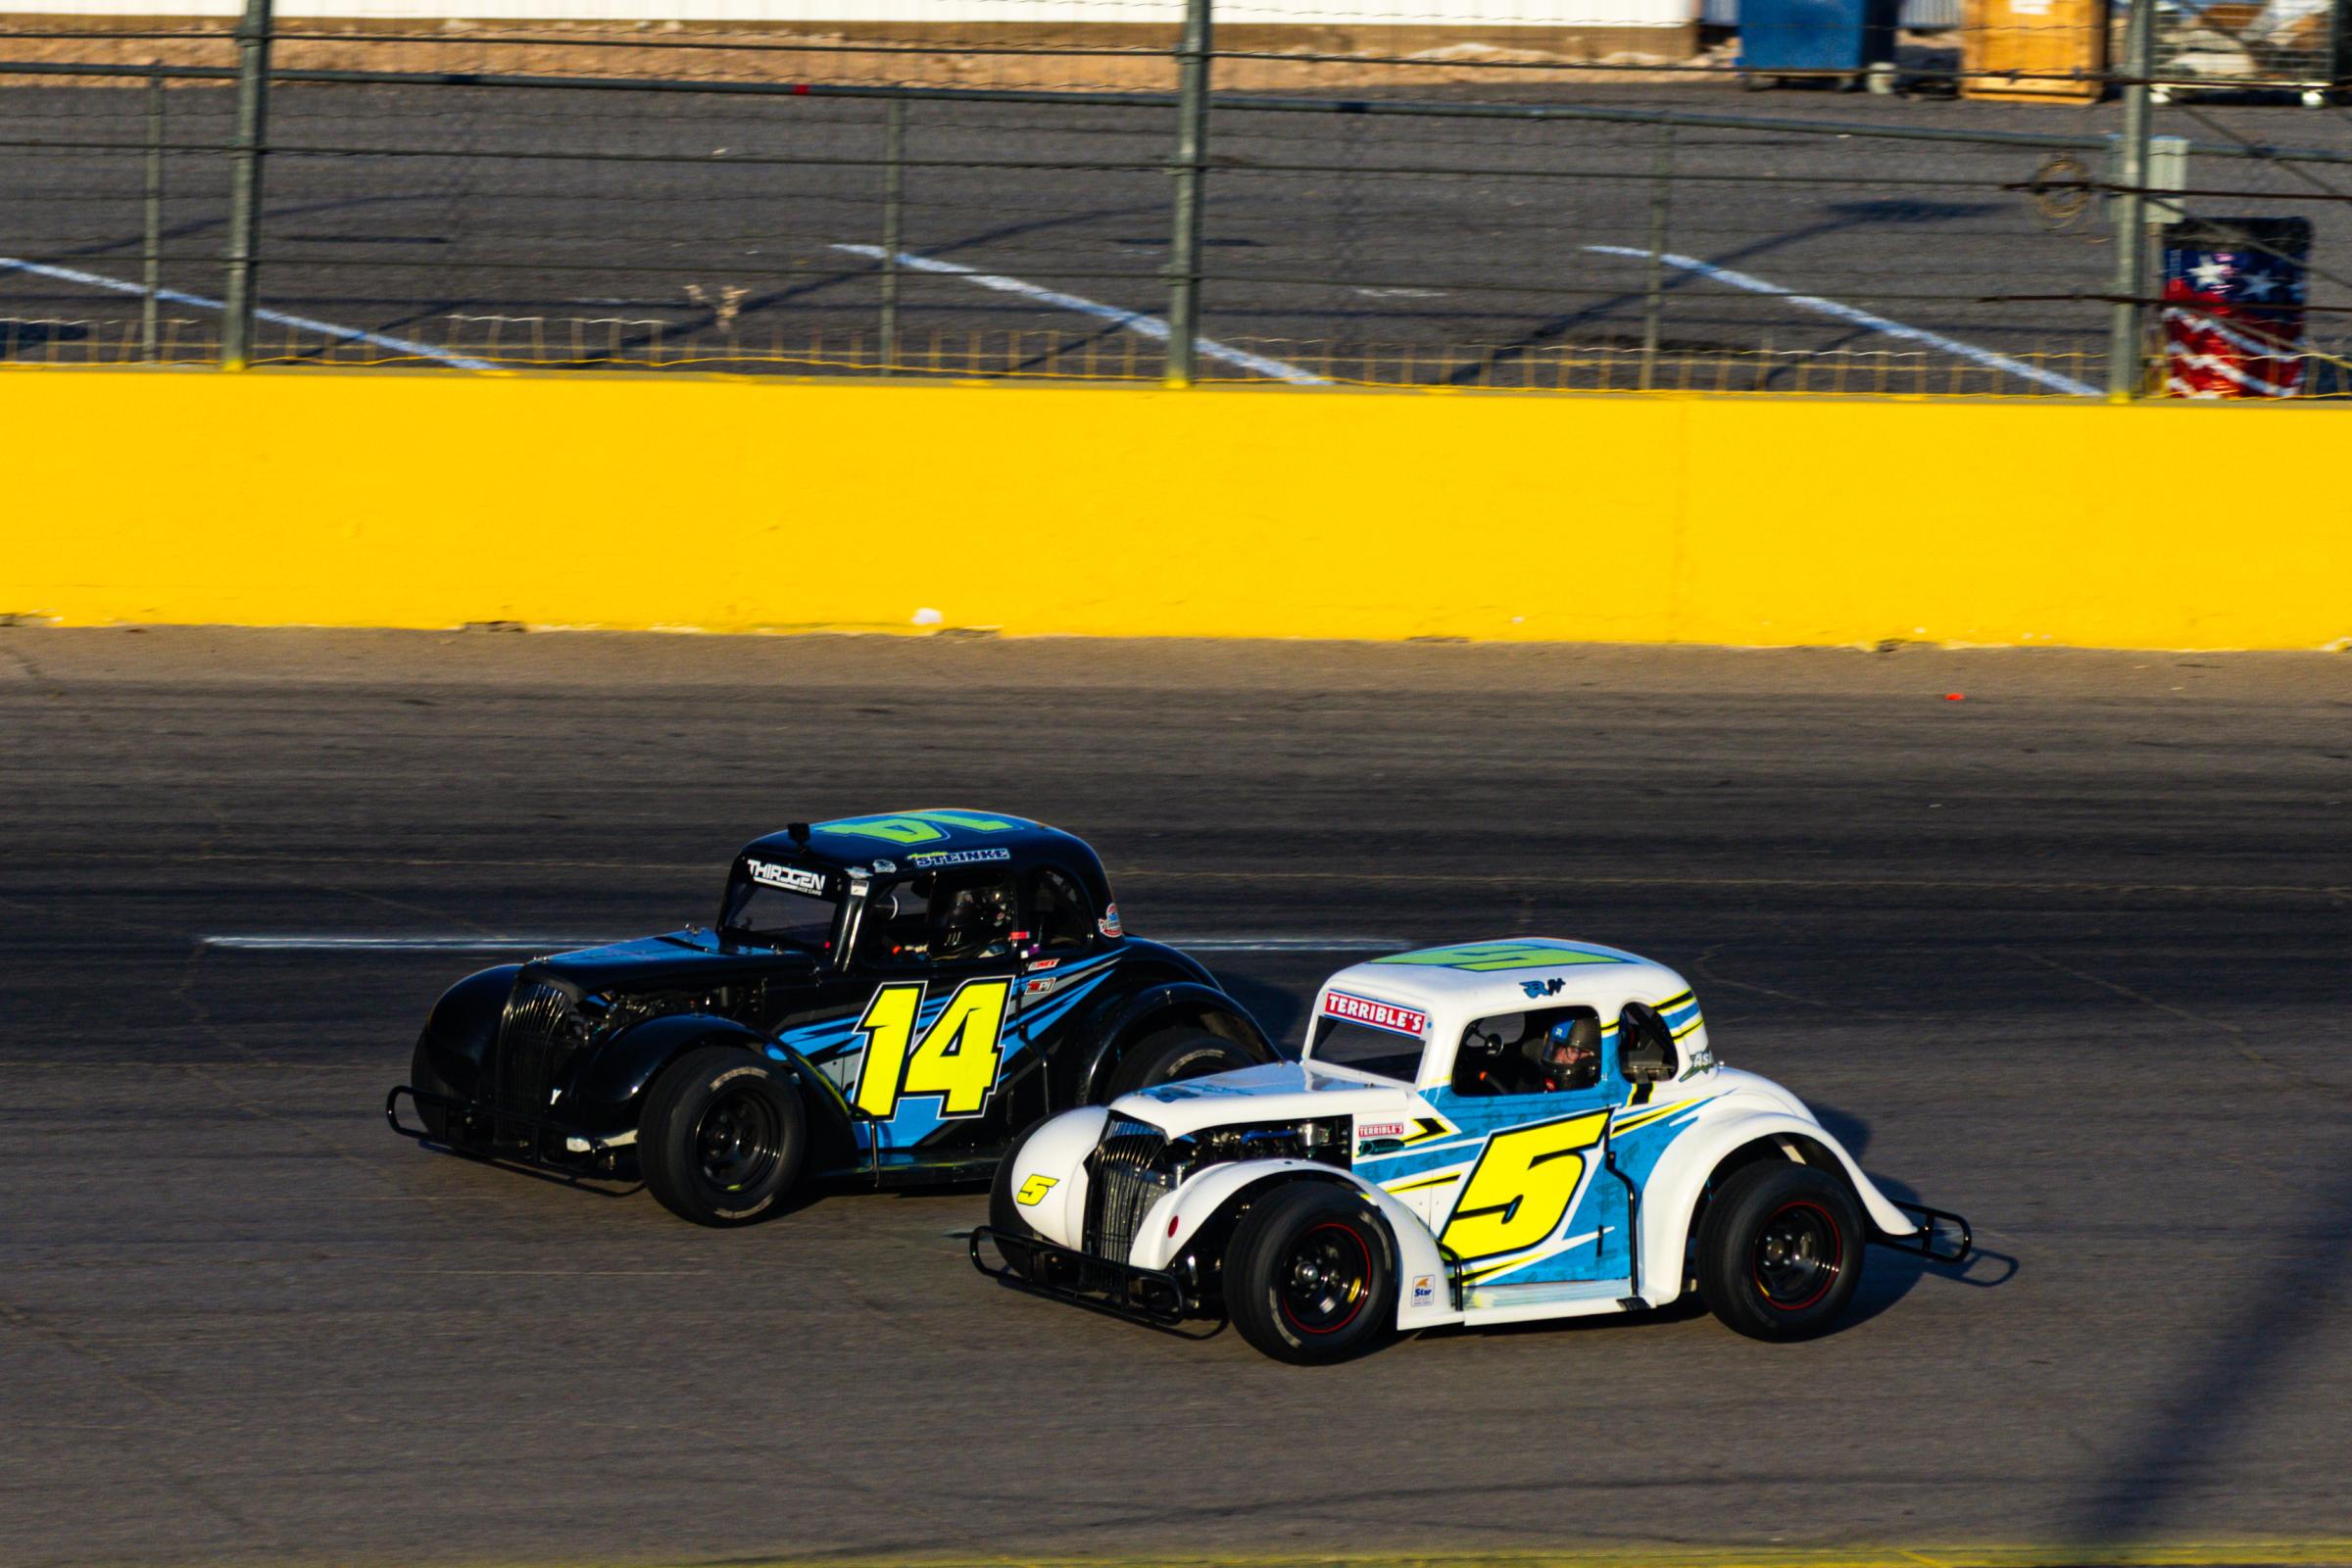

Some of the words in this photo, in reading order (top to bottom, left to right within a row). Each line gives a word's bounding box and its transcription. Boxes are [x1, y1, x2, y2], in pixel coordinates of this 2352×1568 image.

[916, 850, 1009, 867] STEINKE
[1329, 995, 1422, 1032] TERRIBLE'S
[851, 976, 1013, 1121] 14
[1359, 1124, 1403, 1137] TERRIBLE'S
[1016, 1174, 1059, 1206] 5
[1439, 1107, 1614, 1266] 5
[1414, 1288, 1432, 1298] Star
